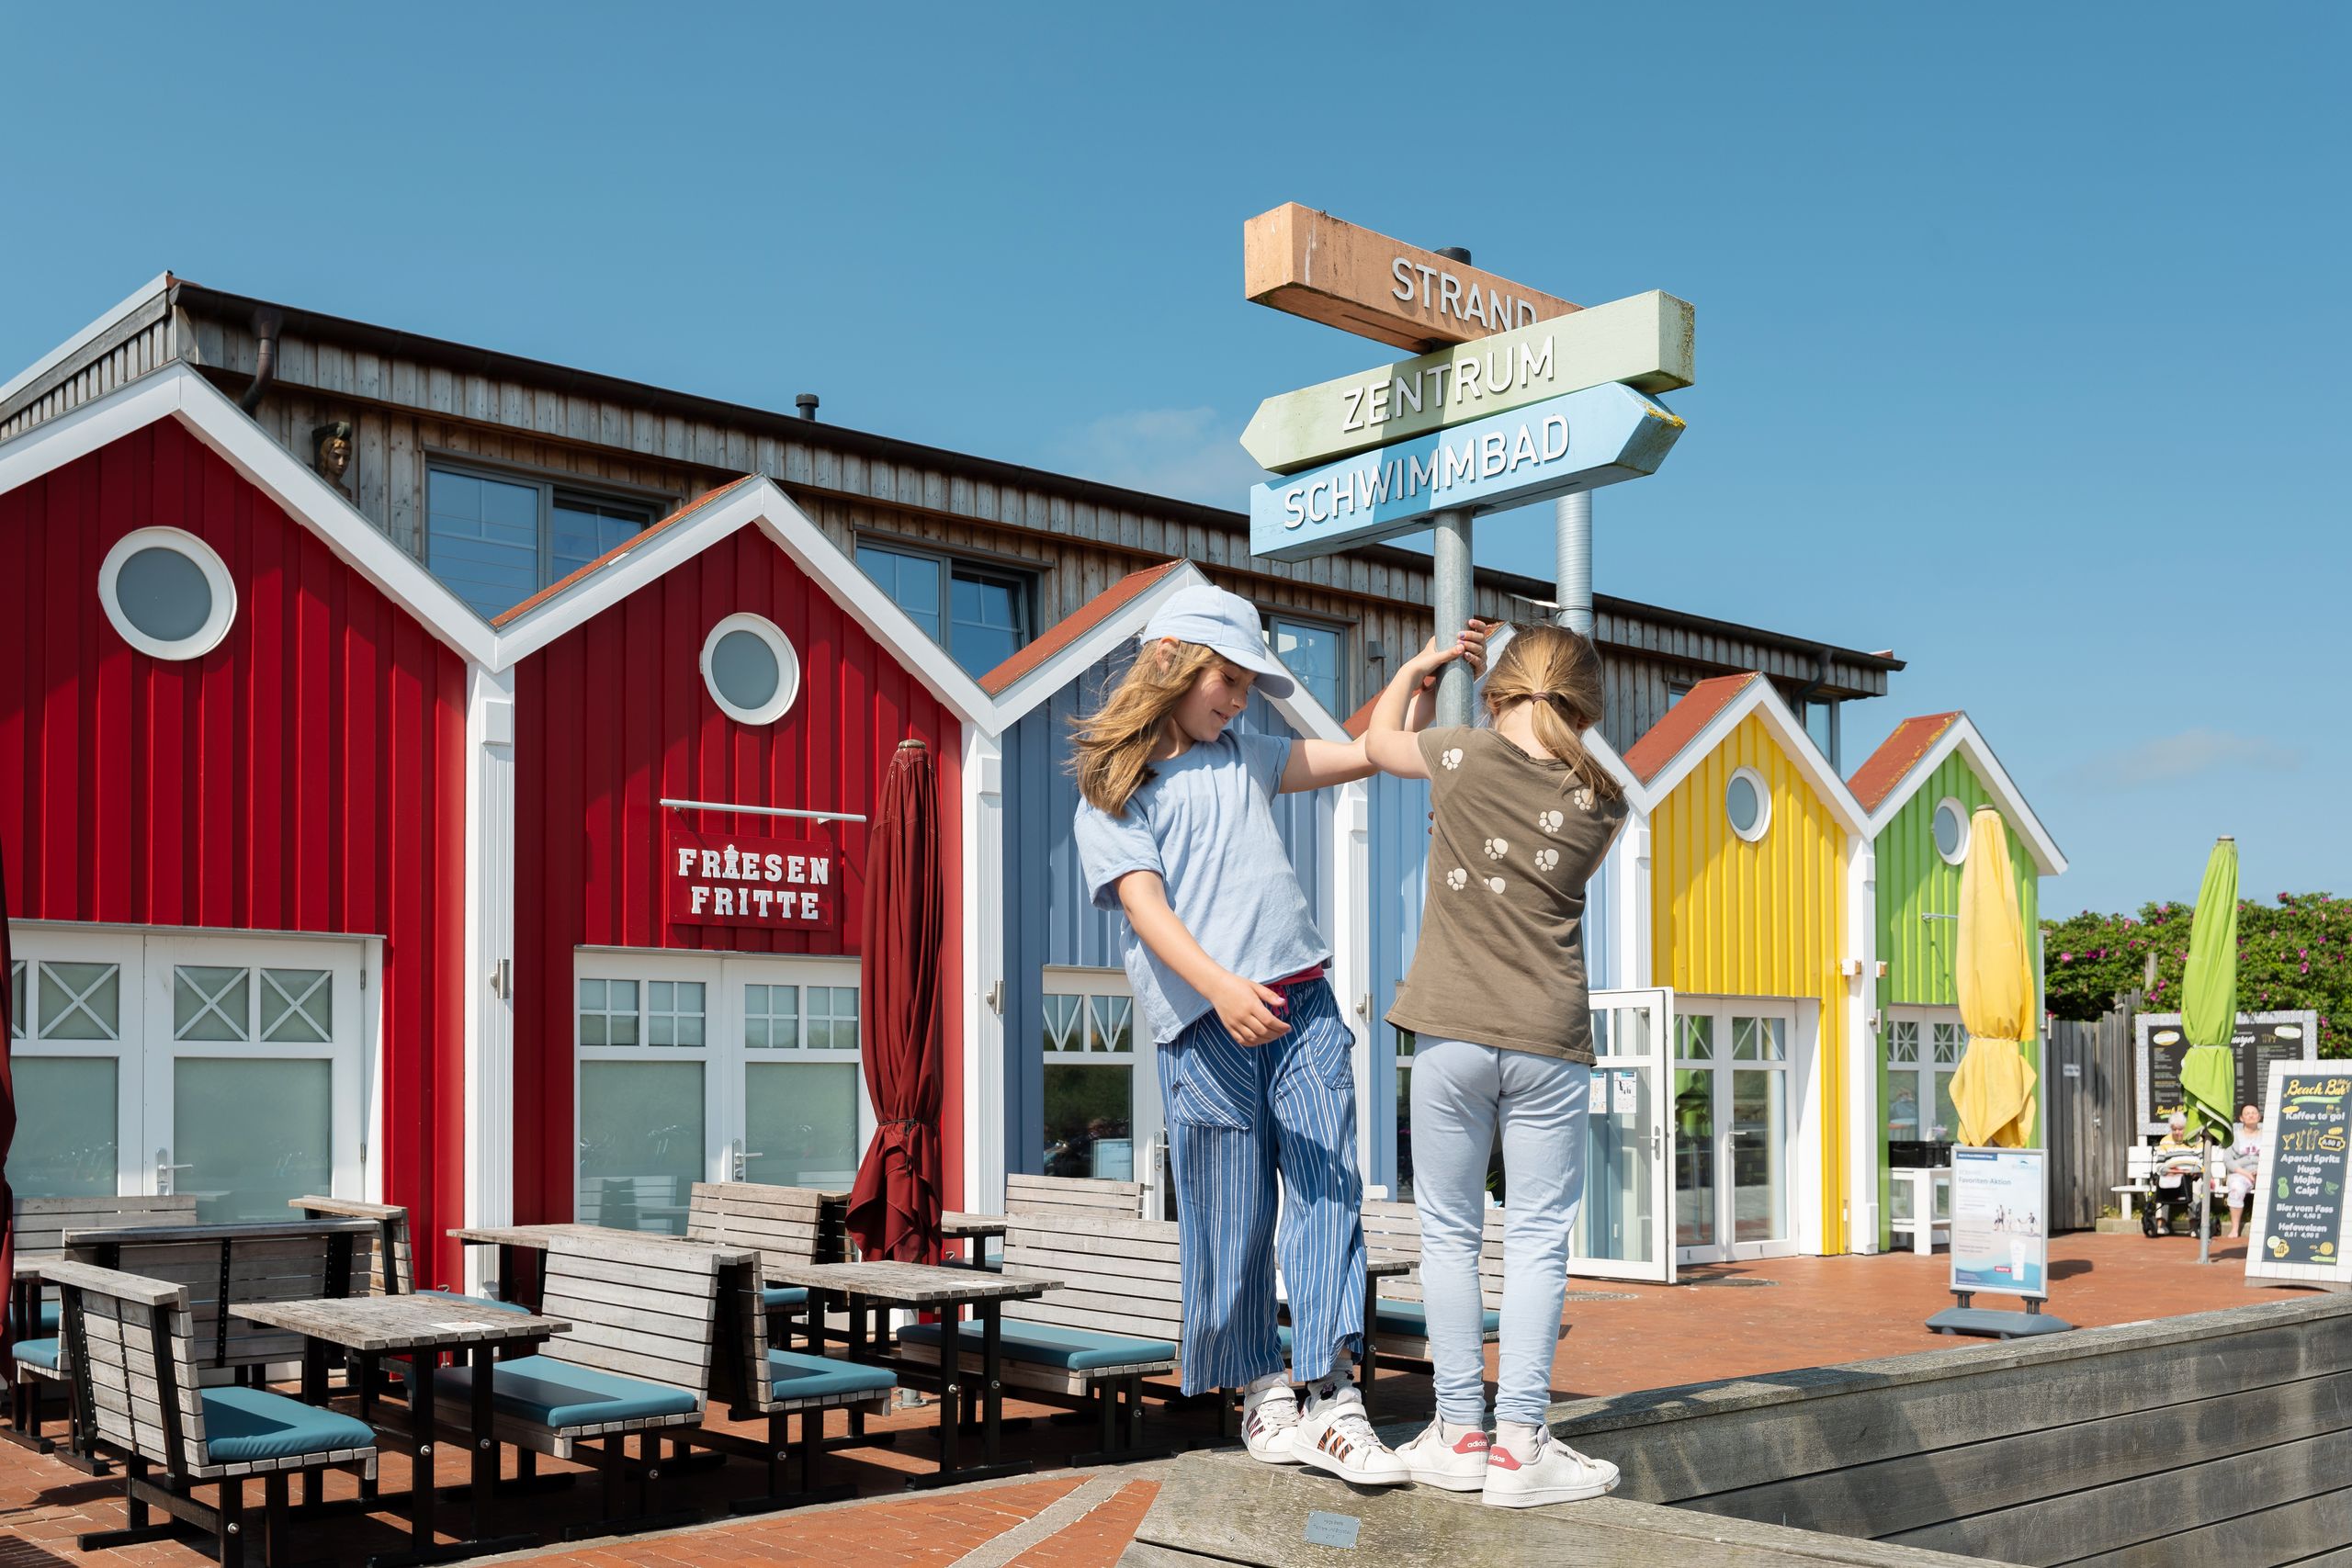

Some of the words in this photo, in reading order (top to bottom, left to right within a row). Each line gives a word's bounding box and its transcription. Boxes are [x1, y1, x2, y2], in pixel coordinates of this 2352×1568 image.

[1342, 335, 1555, 432] ZENTRUM
[1284, 414, 1570, 530] SCHWIMMBAD
[691, 886, 819, 919] FRITTE
[2287, 1079, 2323, 1096] Beach
[2286, 1111, 2316, 1121] Kaffee
[2317, 1112, 2328, 1121] to
[2329, 1111, 2346, 1122] go!
[2280, 1154, 2312, 1165] Aperol
[2313, 1154, 2340, 1165] Spritz
[2297, 1165, 2321, 1175] Hugo
[2293, 1175, 2323, 1186] Mojito
[2295, 1186, 2319, 1197] Caipi
[2276, 1202, 2293, 1213] Bier
[2314, 1204, 2334, 1213] Fass
[2278, 1223, 2327, 1233] Hefeweizen
